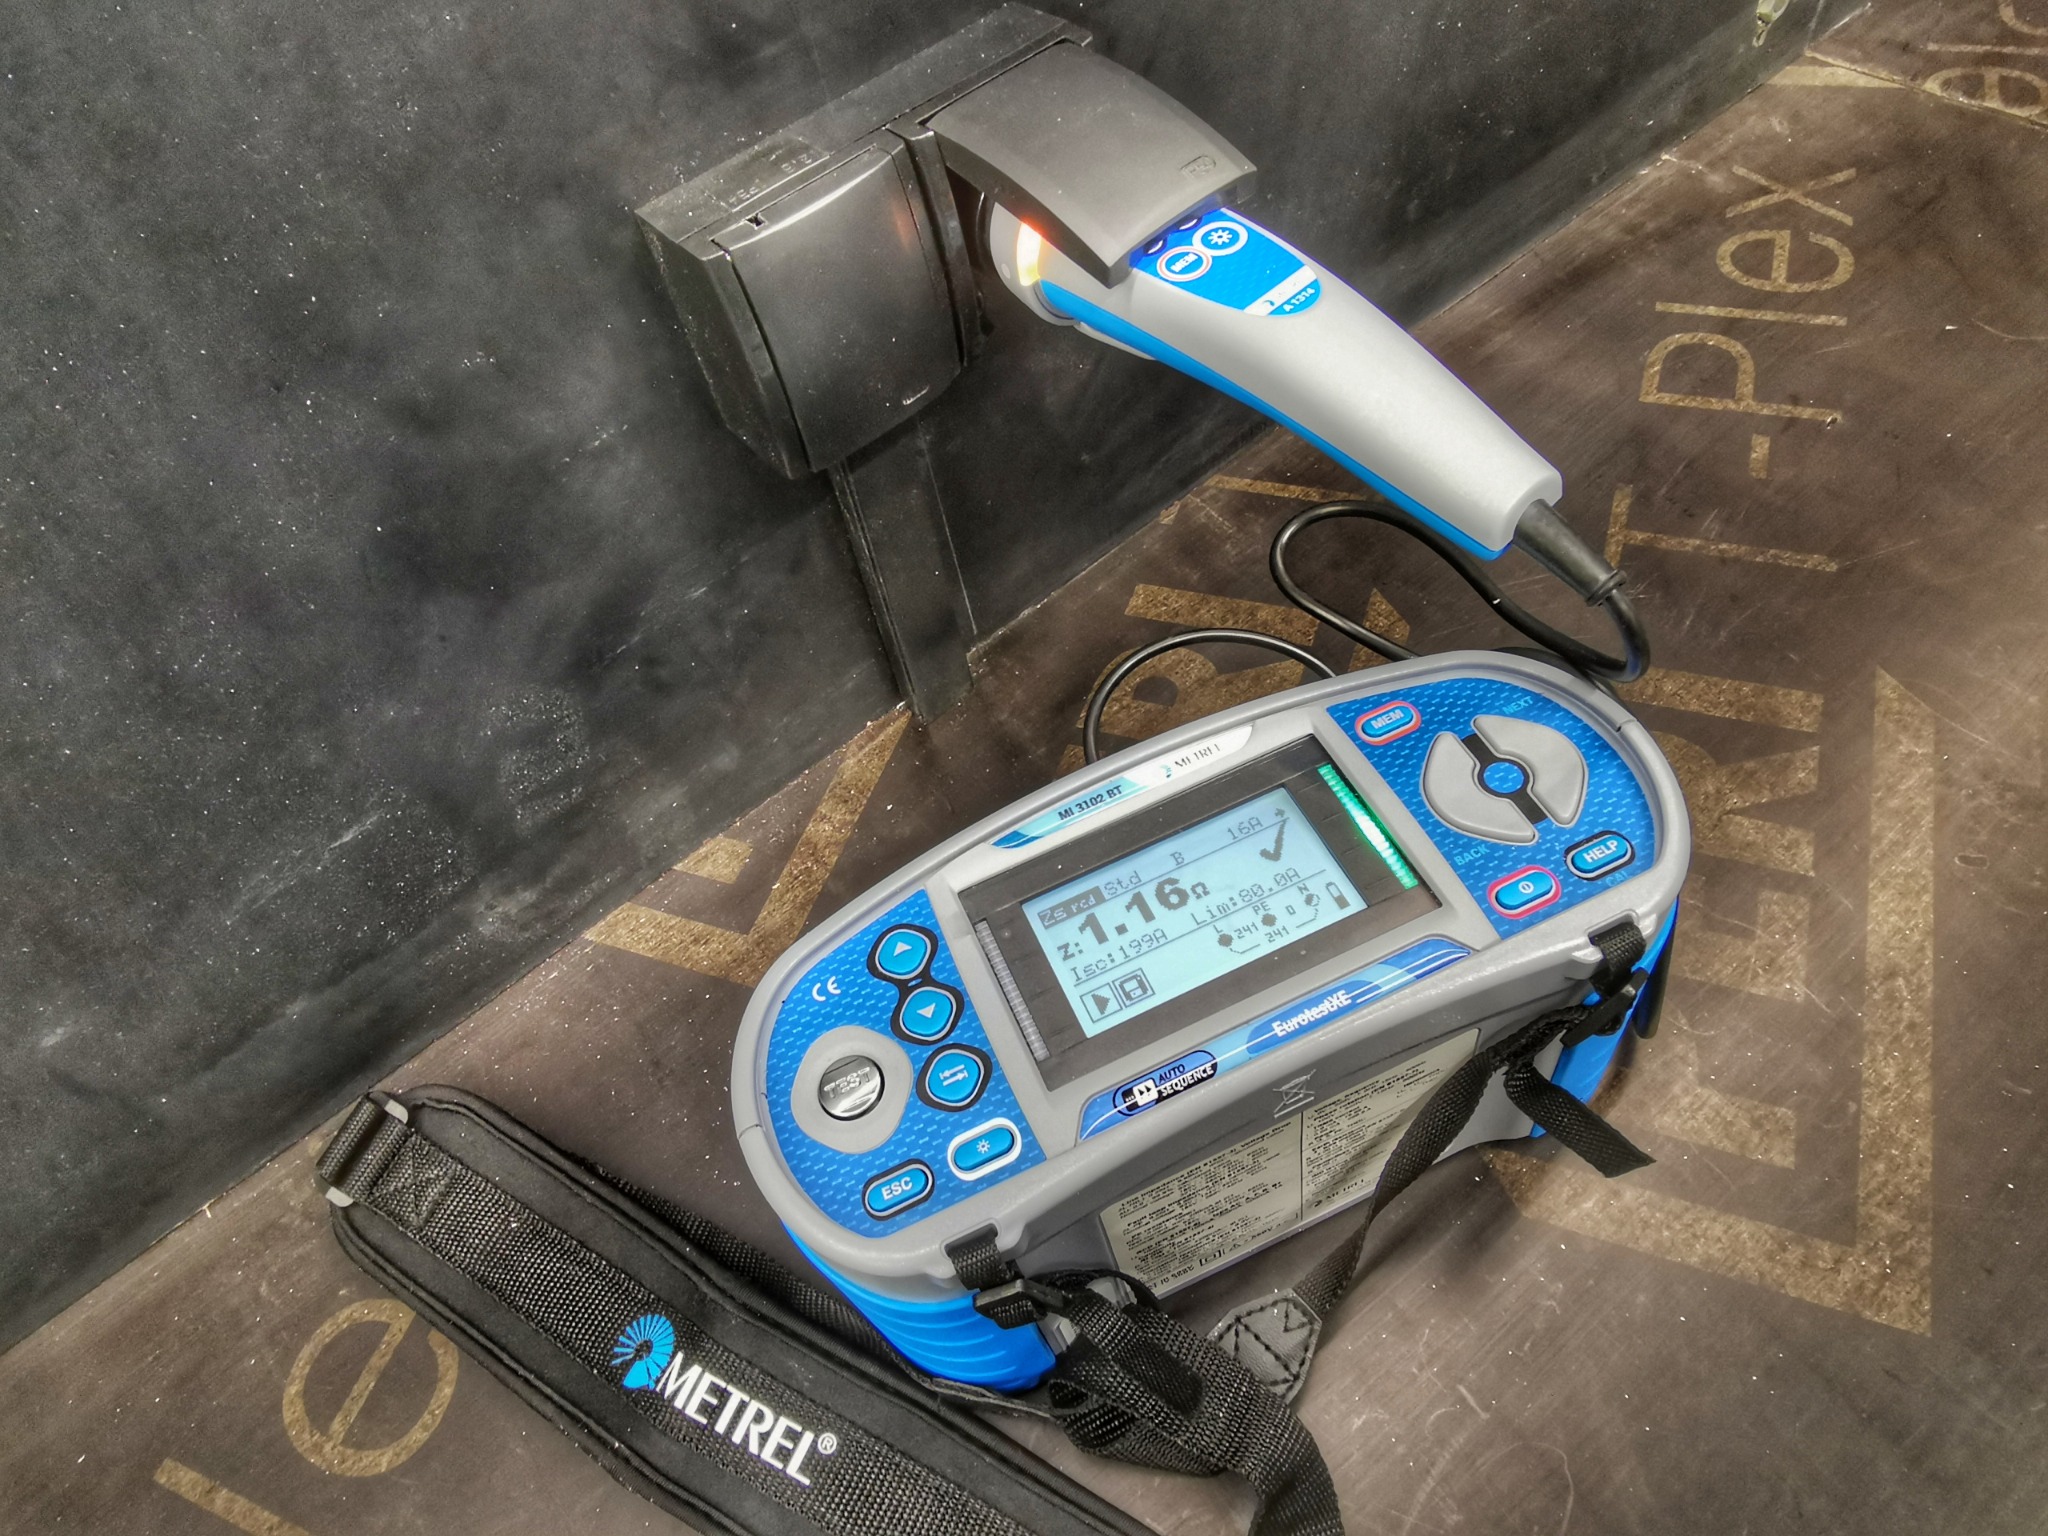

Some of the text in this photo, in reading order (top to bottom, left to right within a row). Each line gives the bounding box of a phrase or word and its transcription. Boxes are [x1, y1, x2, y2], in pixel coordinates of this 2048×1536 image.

[1171, 252, 1199, 273] MEM
[1502, 696, 1533, 714] NEXT
[1371, 709, 1404, 729] MEM
[1058, 784, 1123, 821] MI 3102 BT
[1453, 843, 1490, 866] BACK
[1582, 840, 1618, 863] HELP
[1071, 894, 1097, 914] rcd
[1104, 870, 1142, 896] Std
[1170, 851, 1185, 866] B
[1228, 816, 1263, 841] 16A
[1252, 900, 1271, 915] PE
[1234, 921, 1259, 939] 241
[1265, 925, 1290, 943] 241
[1271, 989, 1352, 1038] EurotestXE
[823, 1066, 870, 1098] TEST
[1159, 1063, 1186, 1084] AUTO
[1160, 1065, 1214, 1098] SEQUENCE
[881, 1177, 913, 1201] ESC
